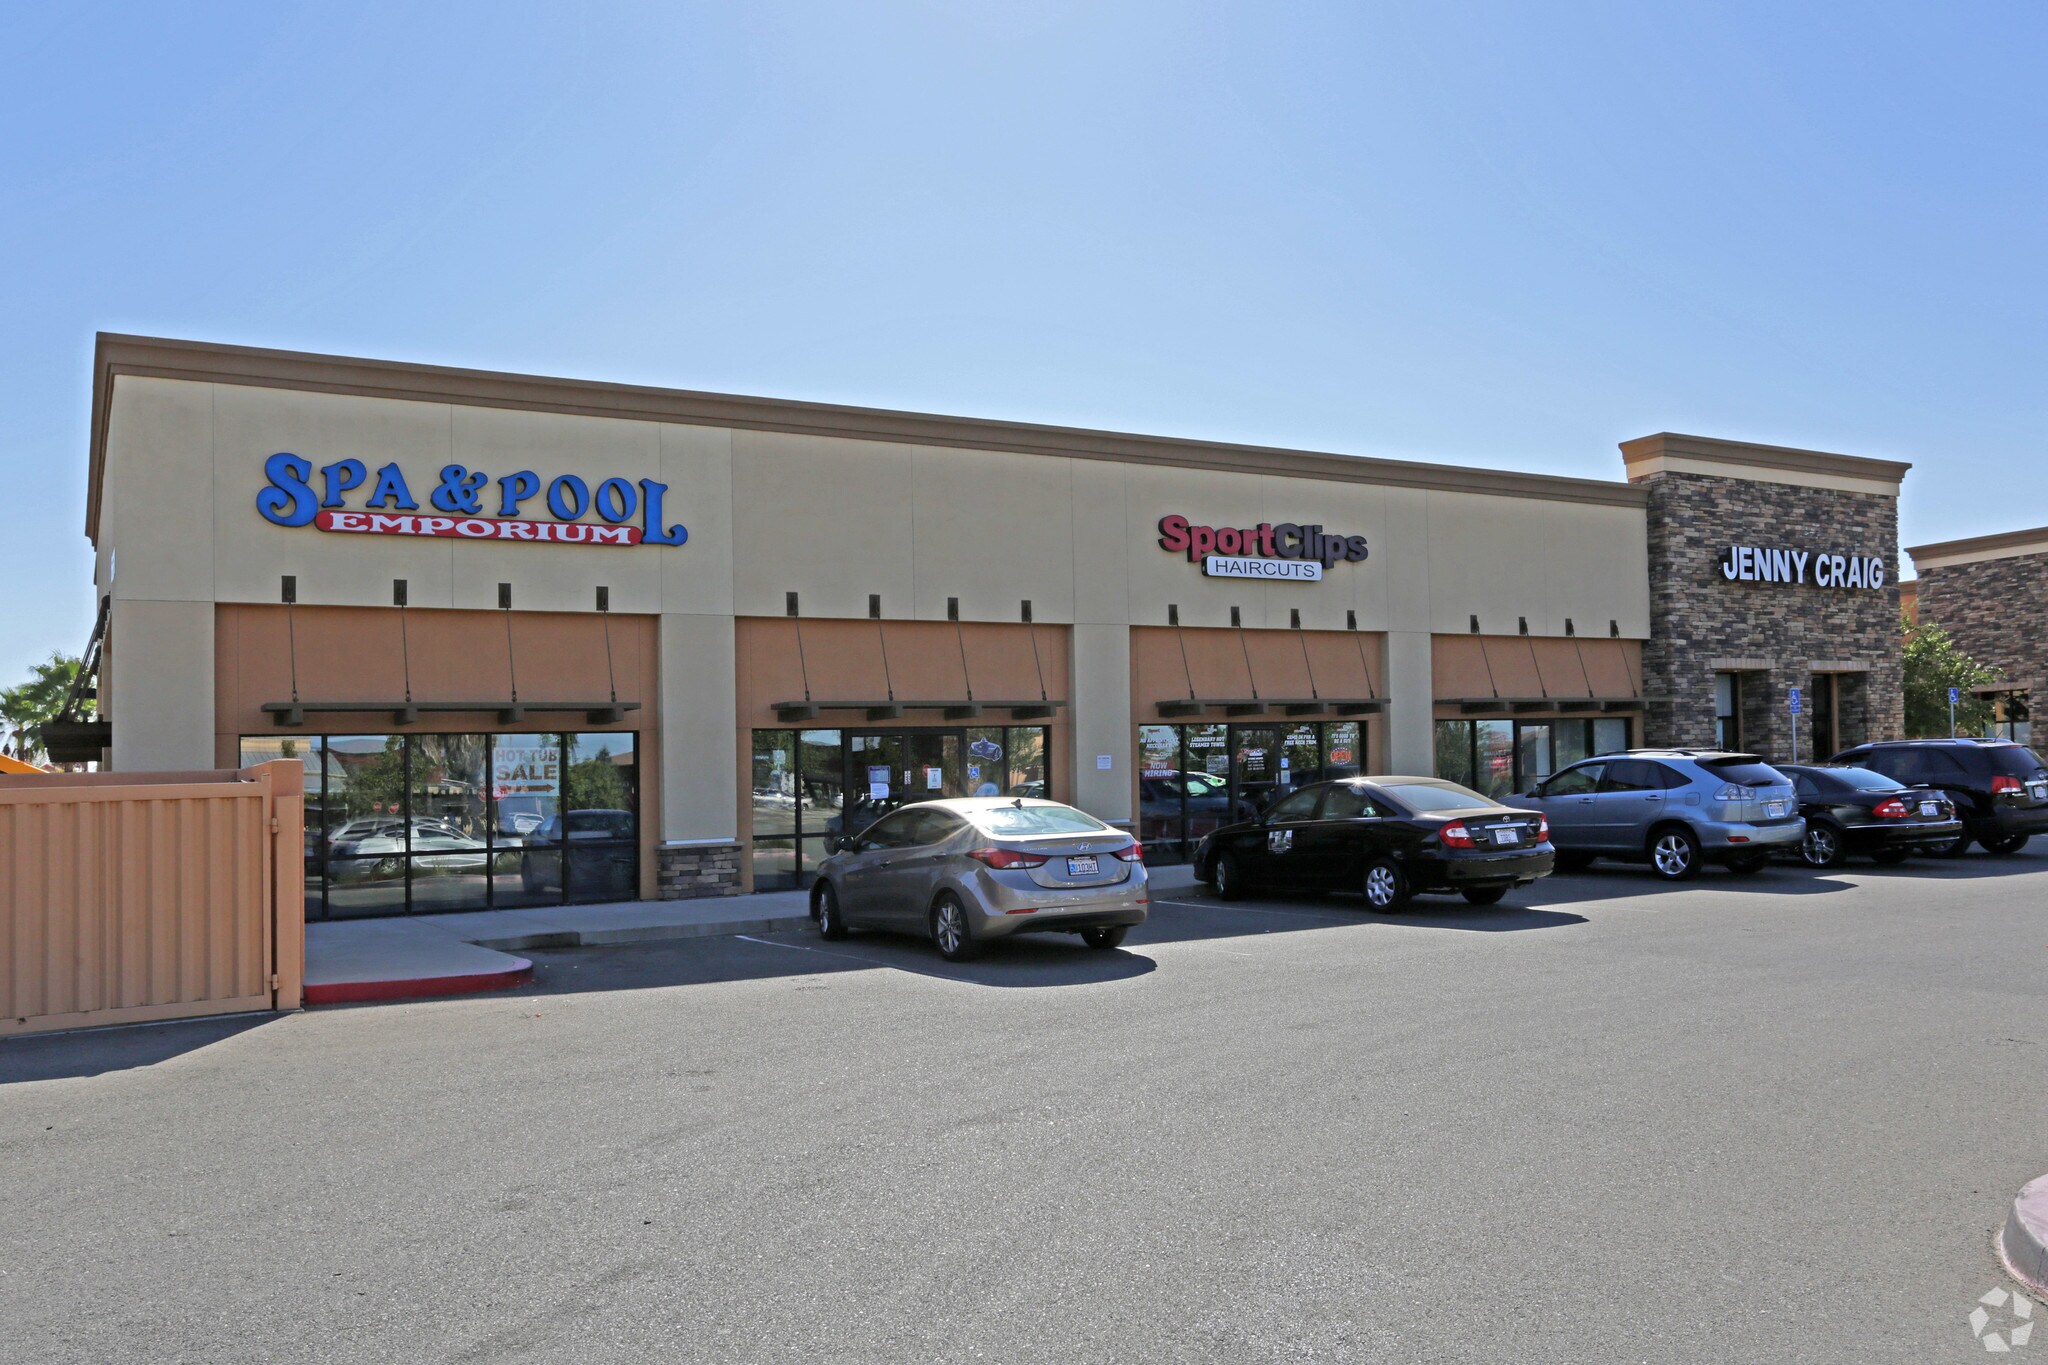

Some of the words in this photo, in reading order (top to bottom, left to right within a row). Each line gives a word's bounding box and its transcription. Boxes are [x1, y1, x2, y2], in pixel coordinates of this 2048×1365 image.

[256, 452, 419, 527] SPA
[497, 470, 689, 546] POOL
[329, 512, 632, 544] EMPORIUM
[1215, 559, 1316, 578] HAIRCUTS
[1723, 546, 1809, 584] JENNY
[1815, 553, 1884, 590] CRAIG
[496, 750, 526, 763] HOT
[530, 749, 558, 762] TUB
[1330, 749, 1352, 762] OPEN
[496, 763, 558, 781] SALE
[1144, 769, 1173, 777] HIRING
[1149, 761, 1168, 769] NOW
